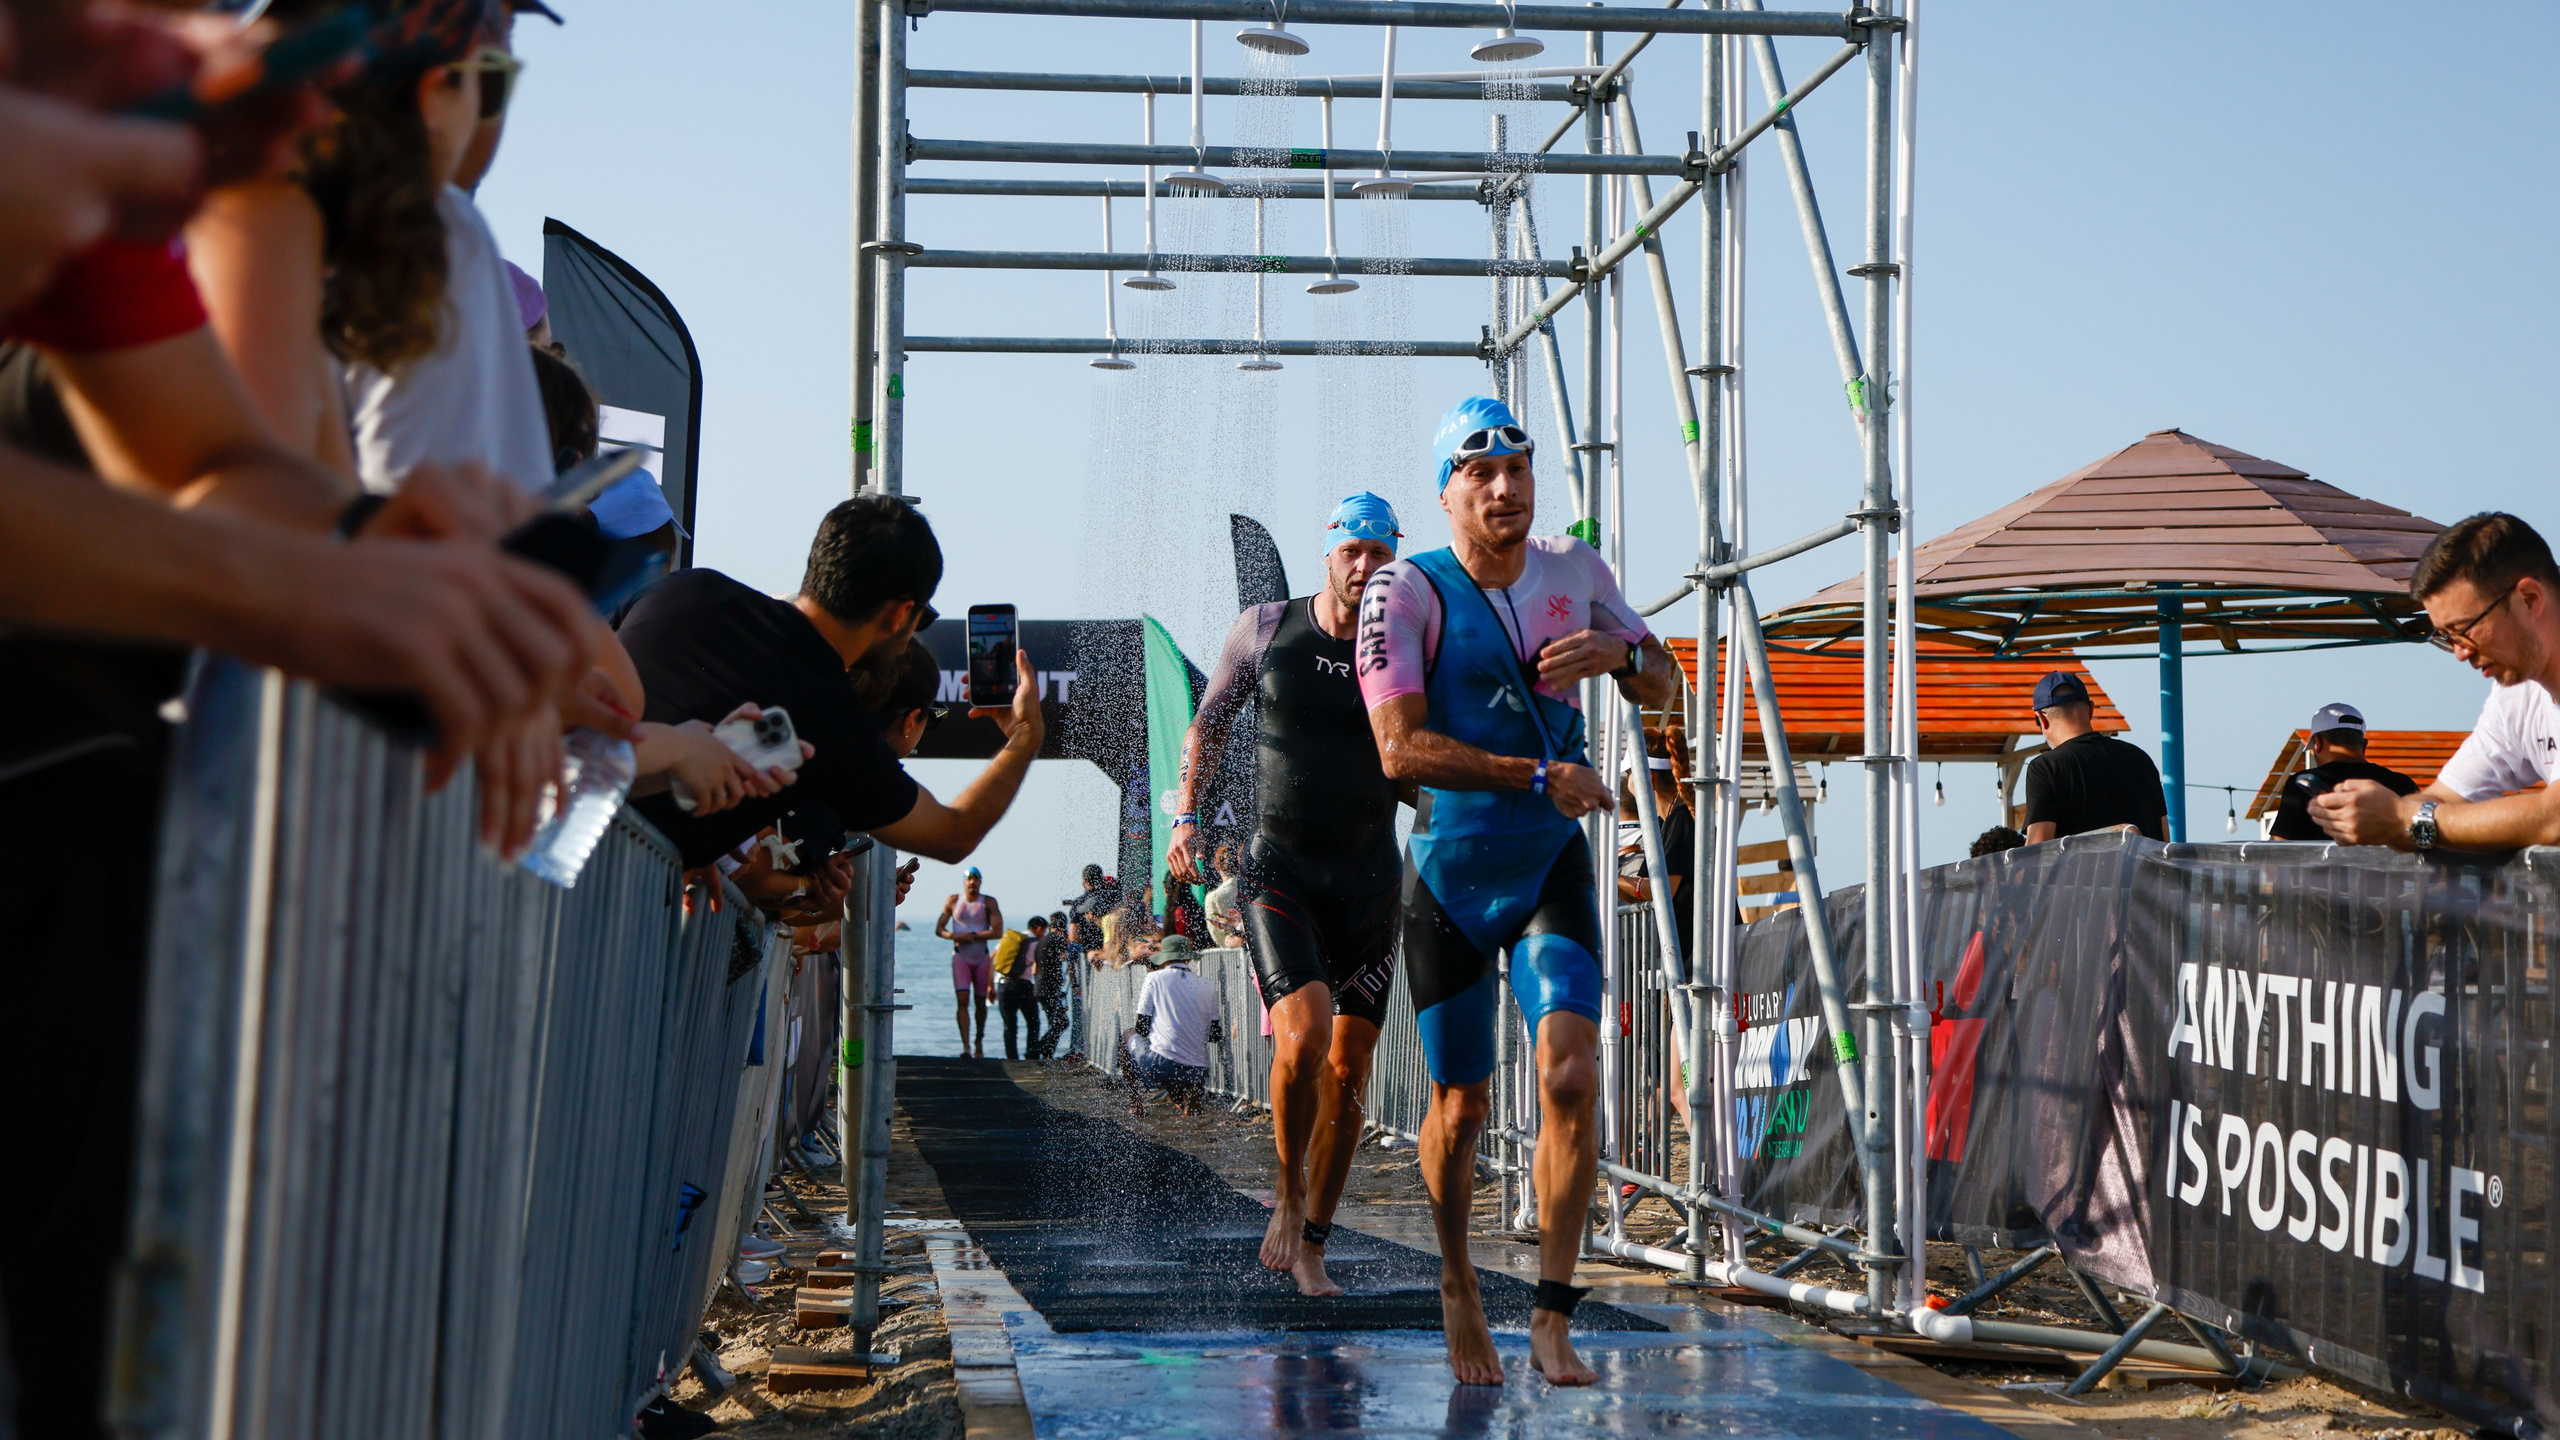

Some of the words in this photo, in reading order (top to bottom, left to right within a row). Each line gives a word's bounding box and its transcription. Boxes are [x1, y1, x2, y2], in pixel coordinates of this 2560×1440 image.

[1315, 655, 1350, 678] TYR
[2168, 962, 2446, 1110] ANYTHING
[2166, 1100, 2209, 1206] IS
